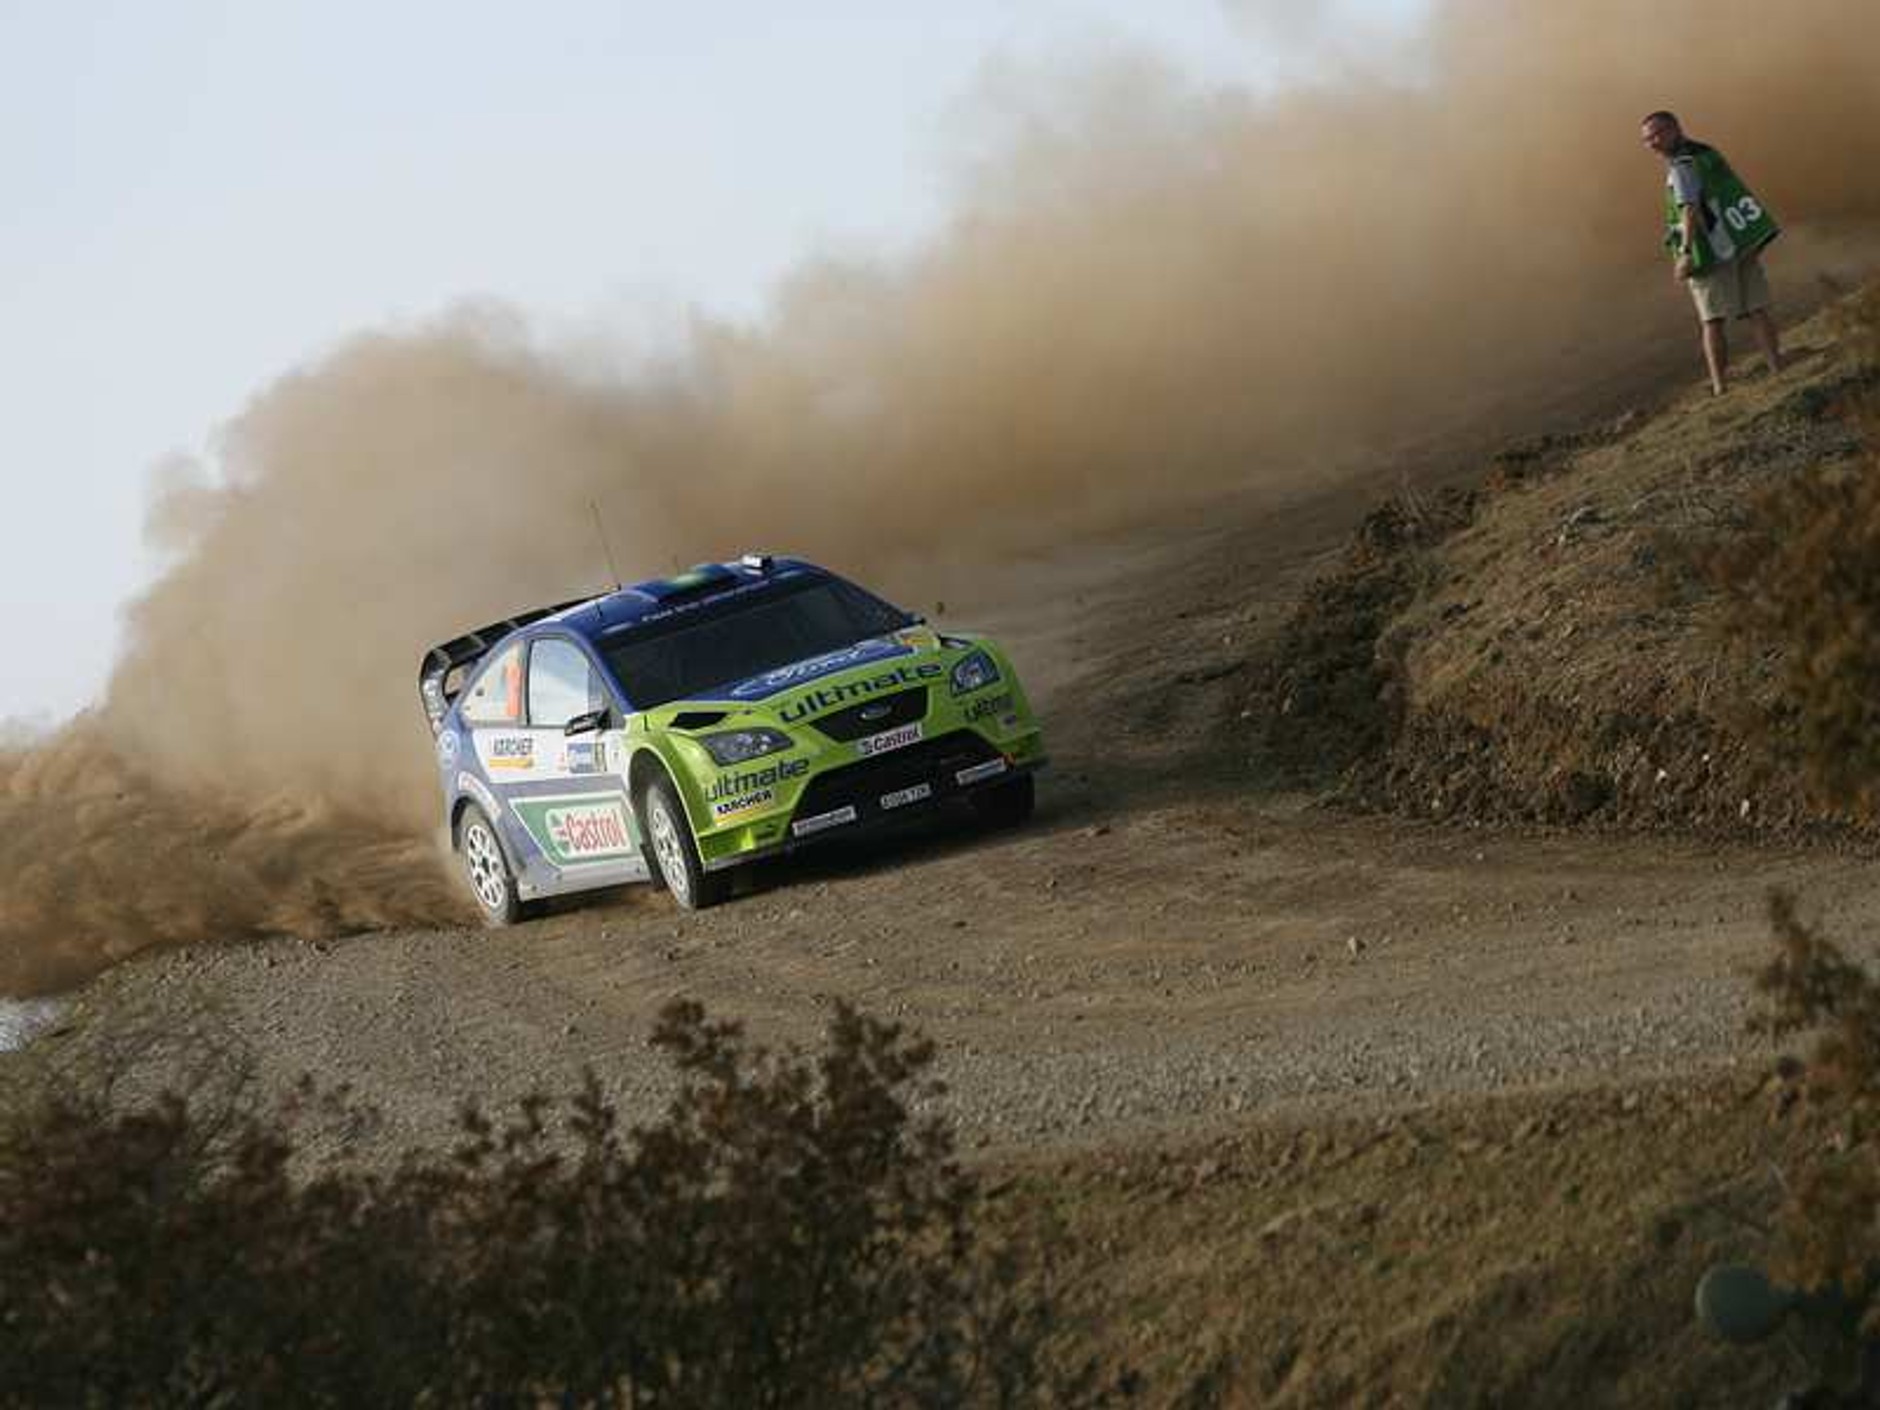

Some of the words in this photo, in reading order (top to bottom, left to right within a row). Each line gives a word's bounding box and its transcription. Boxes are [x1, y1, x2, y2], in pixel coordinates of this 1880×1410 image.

[1724, 196, 1762, 231] 03
[779, 663, 943, 723] ultimate
[704, 757, 810, 803] ultimate
[564, 807, 628, 851] Castrol
